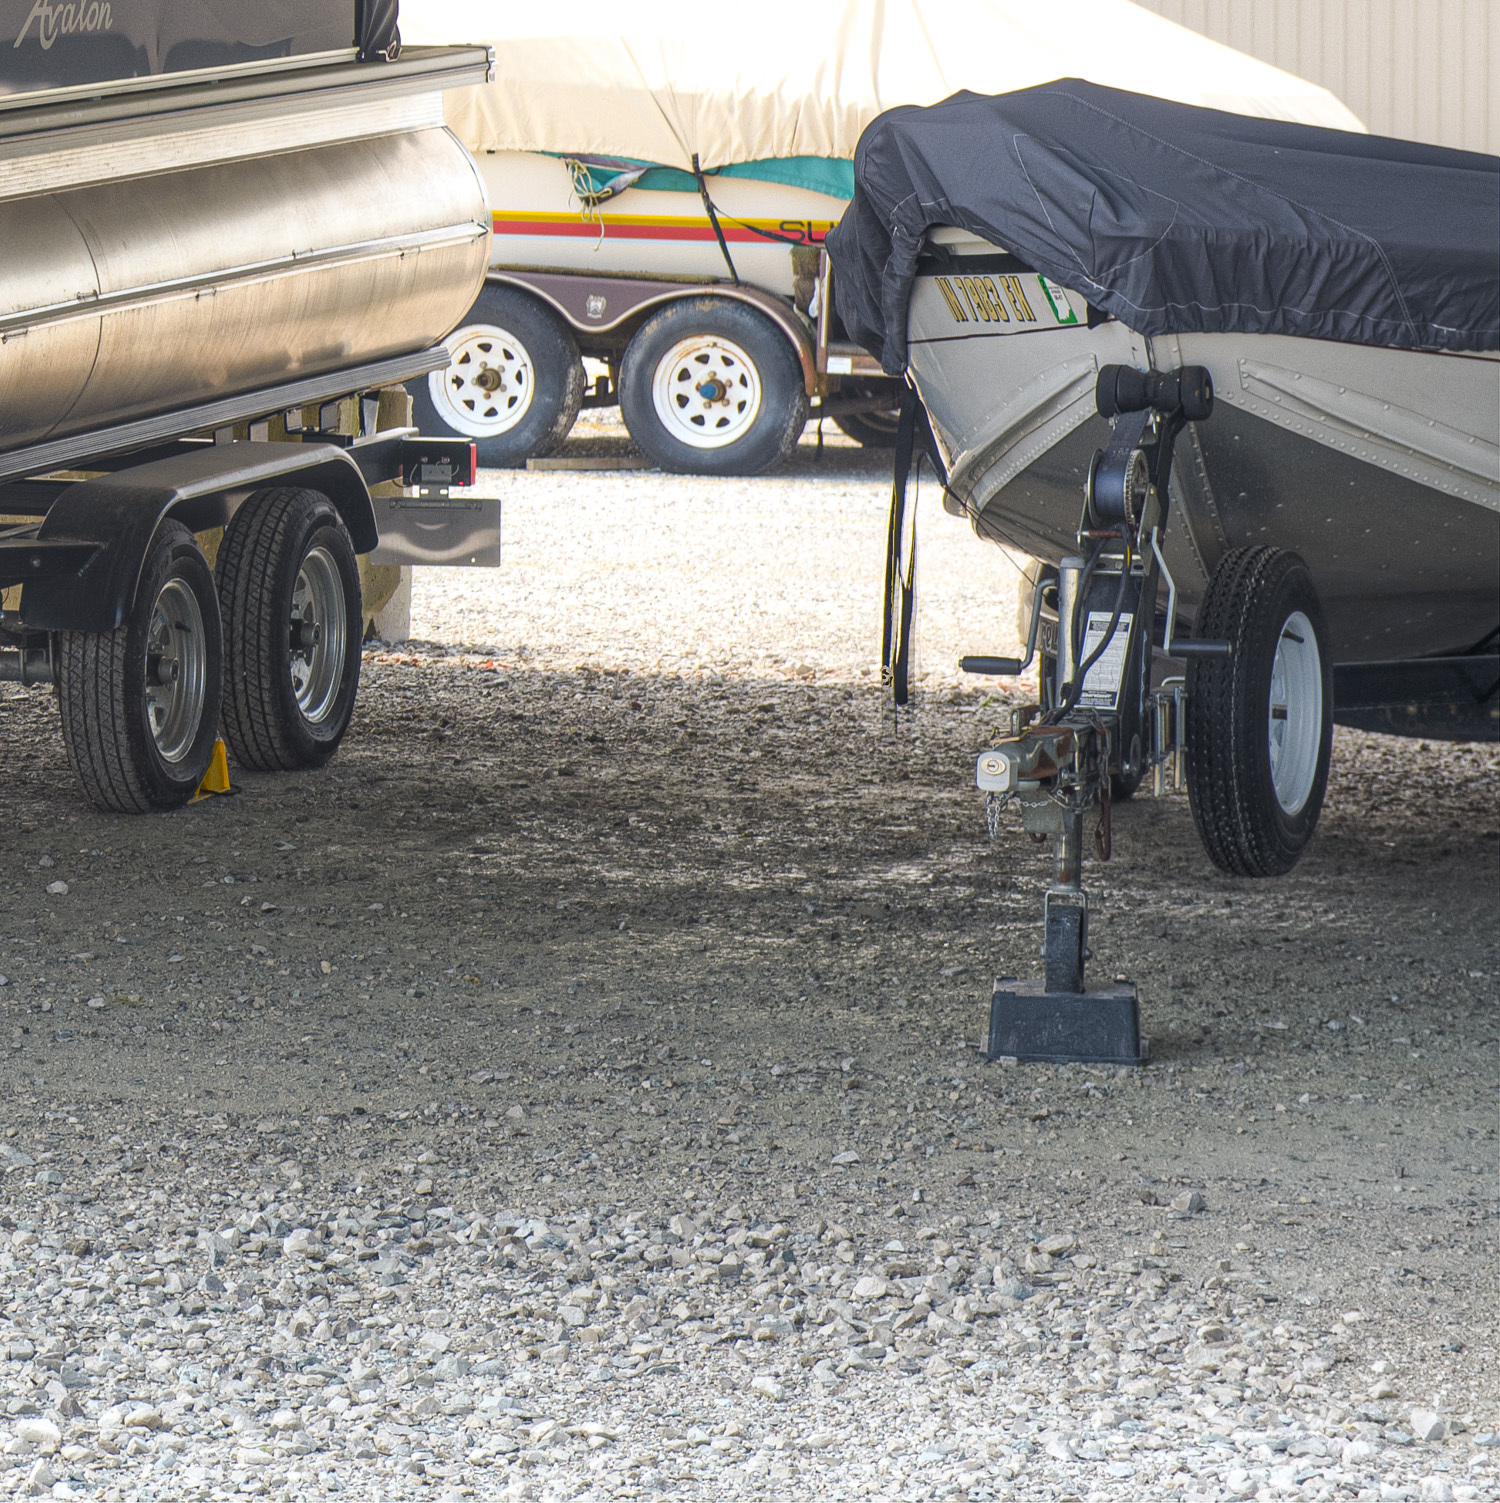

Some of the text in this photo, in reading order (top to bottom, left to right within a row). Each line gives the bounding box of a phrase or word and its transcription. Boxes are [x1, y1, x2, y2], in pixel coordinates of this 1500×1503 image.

[934, 277, 969, 323] IN
[953, 276, 1011, 323] 7983
[998, 275, 1038, 322] EK
